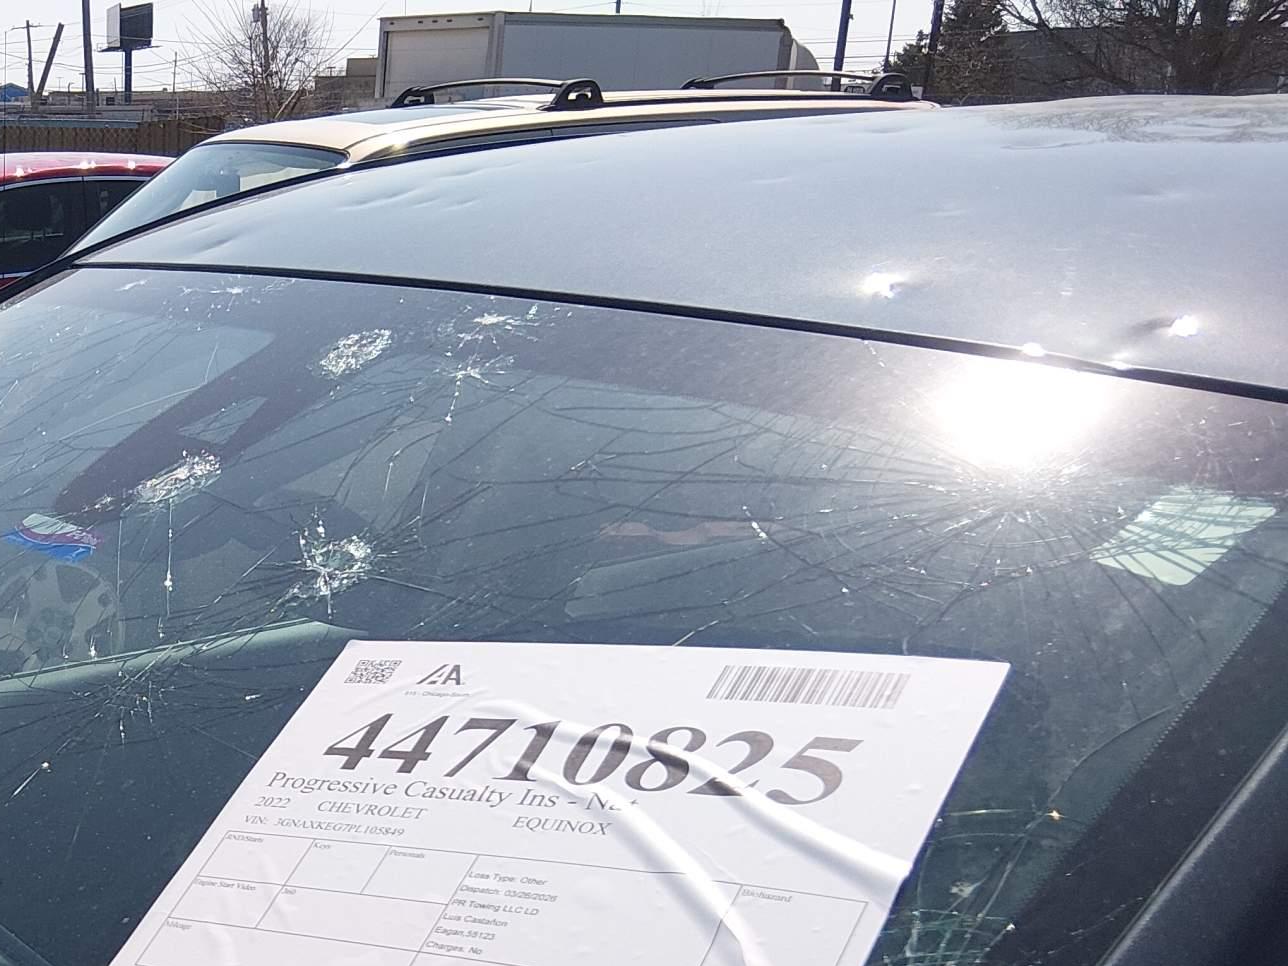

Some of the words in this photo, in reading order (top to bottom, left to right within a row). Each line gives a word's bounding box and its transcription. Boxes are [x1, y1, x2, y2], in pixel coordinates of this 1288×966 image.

[323, 712, 865, 806] 44710825
[266, 771, 398, 794] Progressive
[404, 779, 513, 808] Casualty
[516, 788, 560, 808] Ins
[254, 796, 292, 809] 2022
[317, 800, 428, 820] CHEVROLET
[512, 816, 612, 836] EQUINOX
[520, 876, 548, 886] Other
[468, 900, 501, 913] Towing
[468, 946, 483, 955] No
